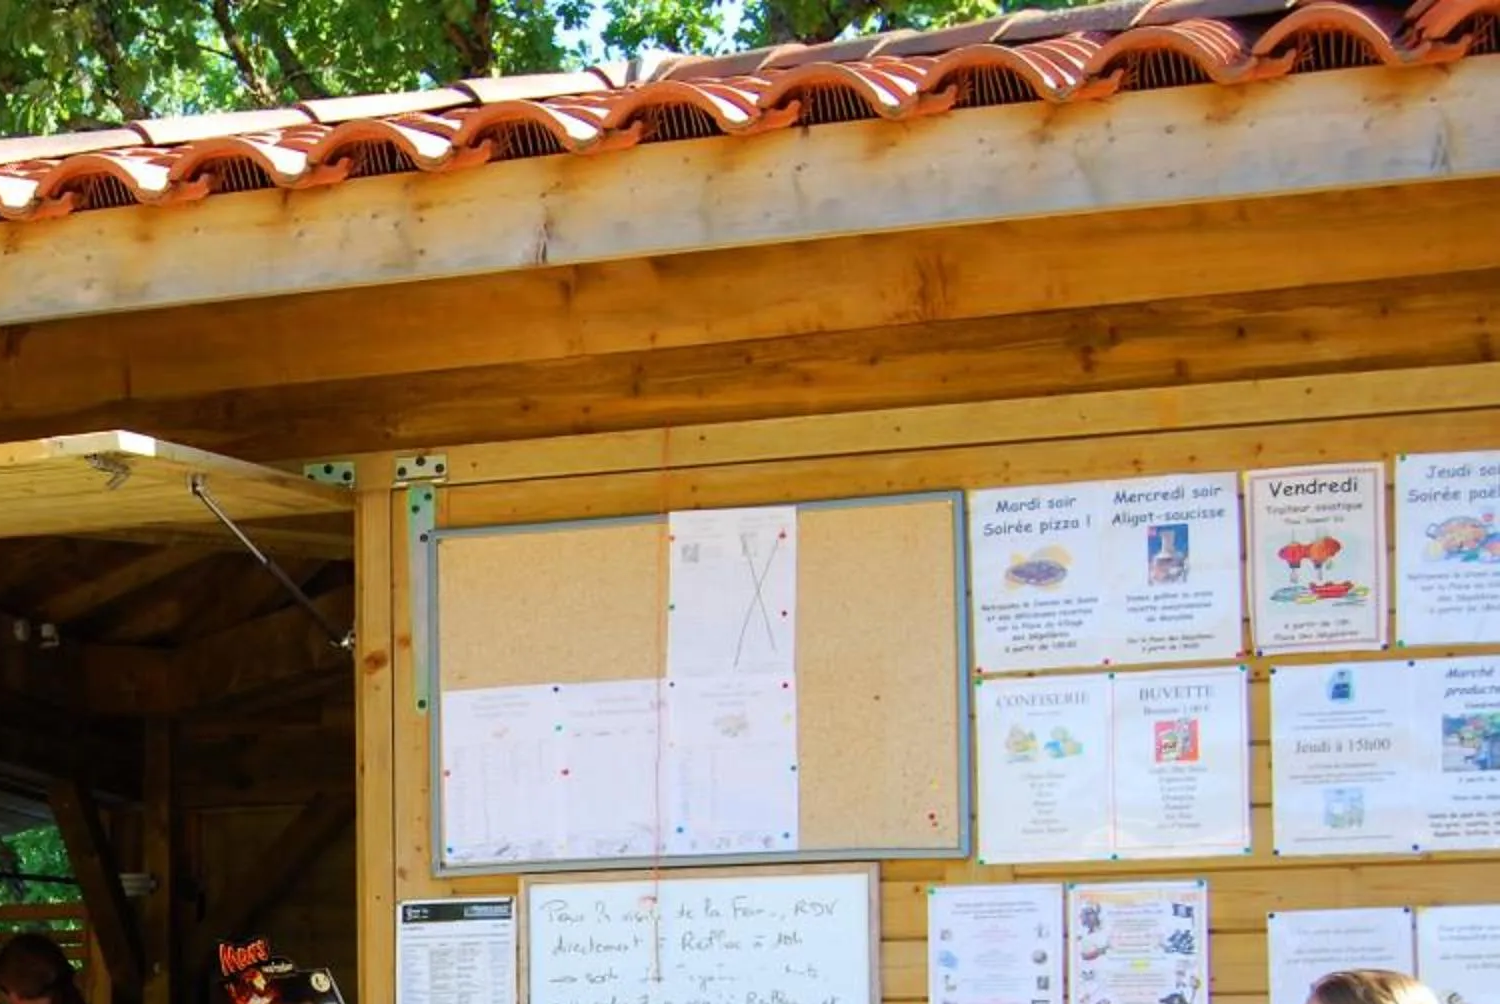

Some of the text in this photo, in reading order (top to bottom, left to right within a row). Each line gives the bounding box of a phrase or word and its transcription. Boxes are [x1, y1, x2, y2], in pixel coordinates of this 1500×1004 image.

[1424, 463, 1471, 479] Jeudi
[1112, 484, 1222, 506] Mercredi soir
[1268, 476, 1359, 498] Vendredi
[1406, 484, 1462, 504] Soirée
[995, 494, 1077, 514] Mardi soir
[983, 519, 1033, 537] Soirée
[1039, 515, 1080, 535] pizza
[995, 690, 1090, 708] CONFISERIE
[1139, 684, 1215, 702] BUVETTE
